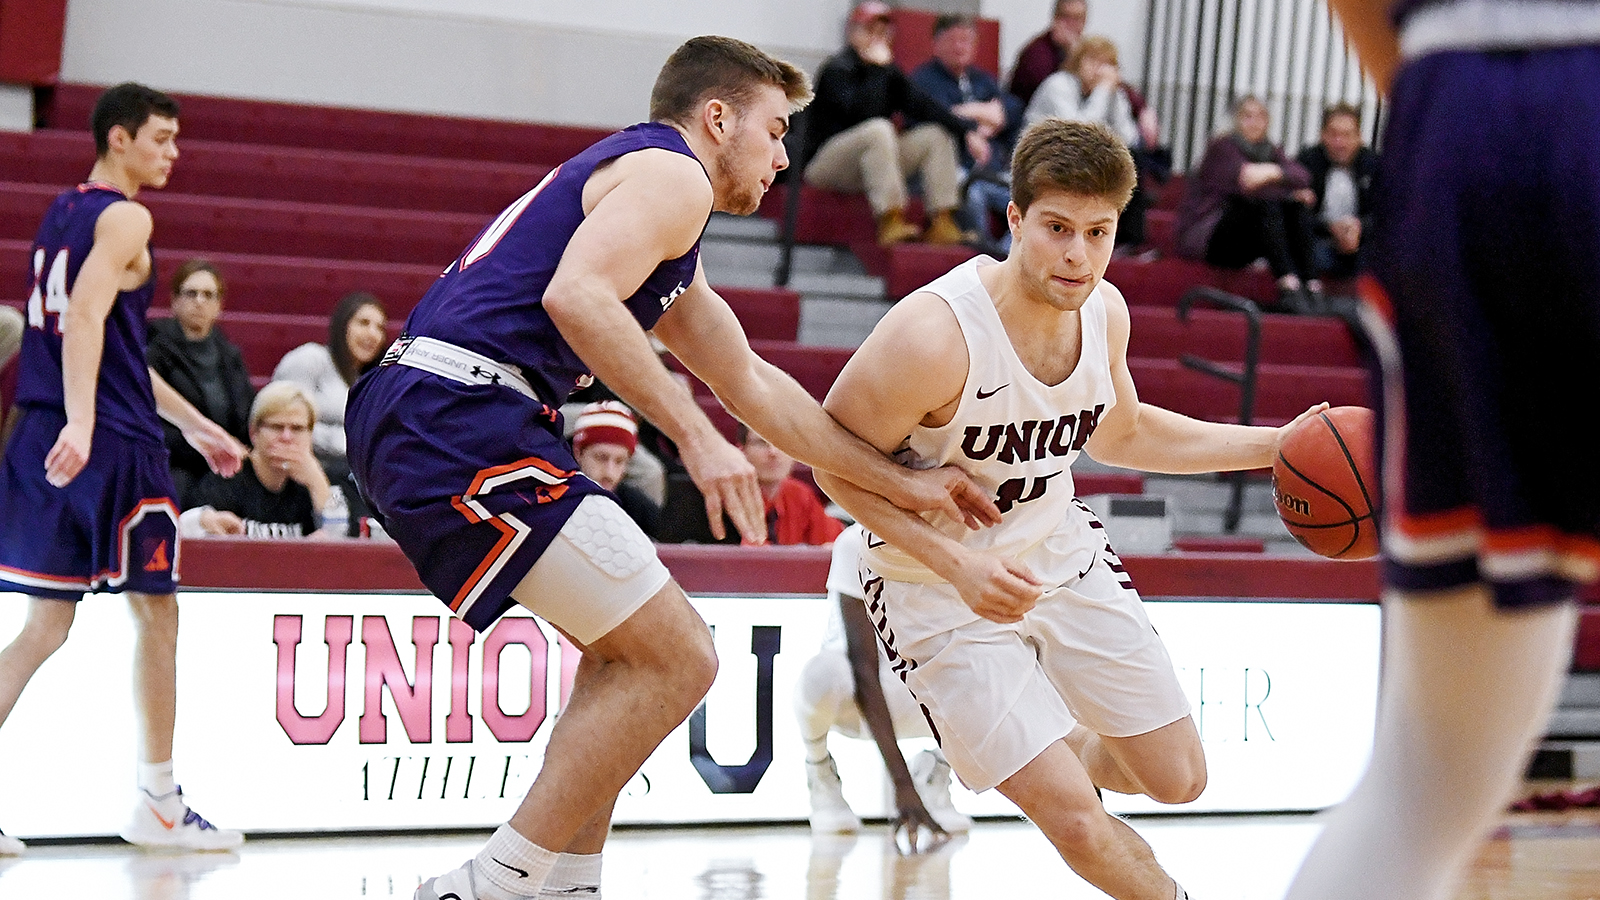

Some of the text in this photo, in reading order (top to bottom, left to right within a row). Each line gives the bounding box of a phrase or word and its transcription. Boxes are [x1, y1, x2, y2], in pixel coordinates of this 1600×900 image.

[431, 353, 467, 370] UNDER
[961, 404, 1105, 465] UNION
[689, 625, 782, 794] U
